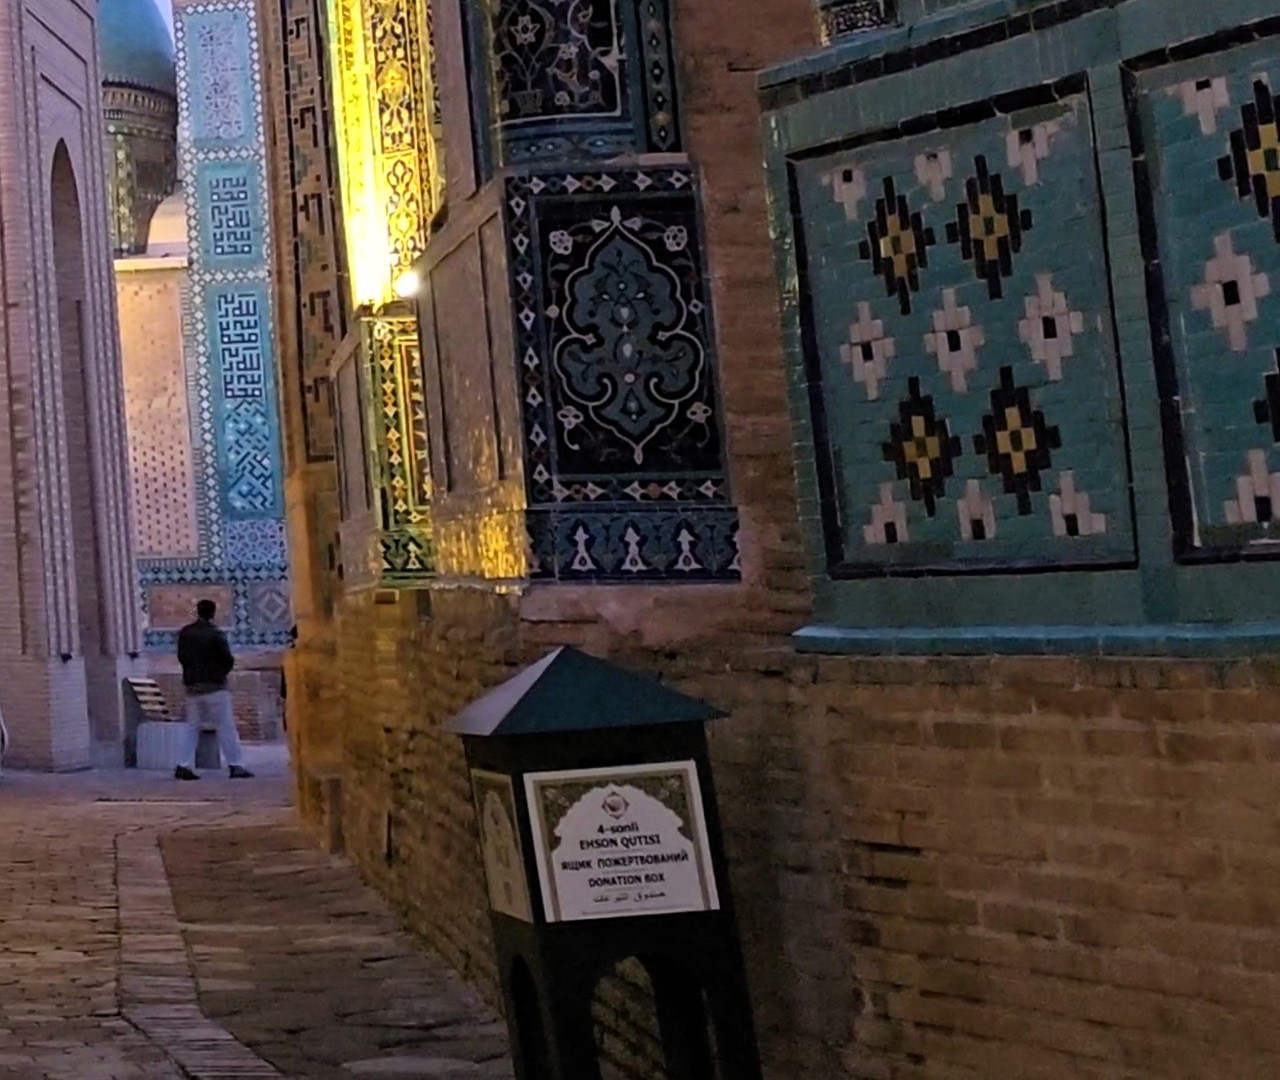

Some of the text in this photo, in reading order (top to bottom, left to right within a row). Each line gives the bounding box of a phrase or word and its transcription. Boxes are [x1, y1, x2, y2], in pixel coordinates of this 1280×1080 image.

[597, 821, 639, 834] 4-sonli
[579, 834, 661, 850] EHSON QUTISI
[561, 849, 689, 870] ЯЩИК ПОЖЕРТВОВАНИЙ
[588, 873, 665, 887] DONATION BOX
